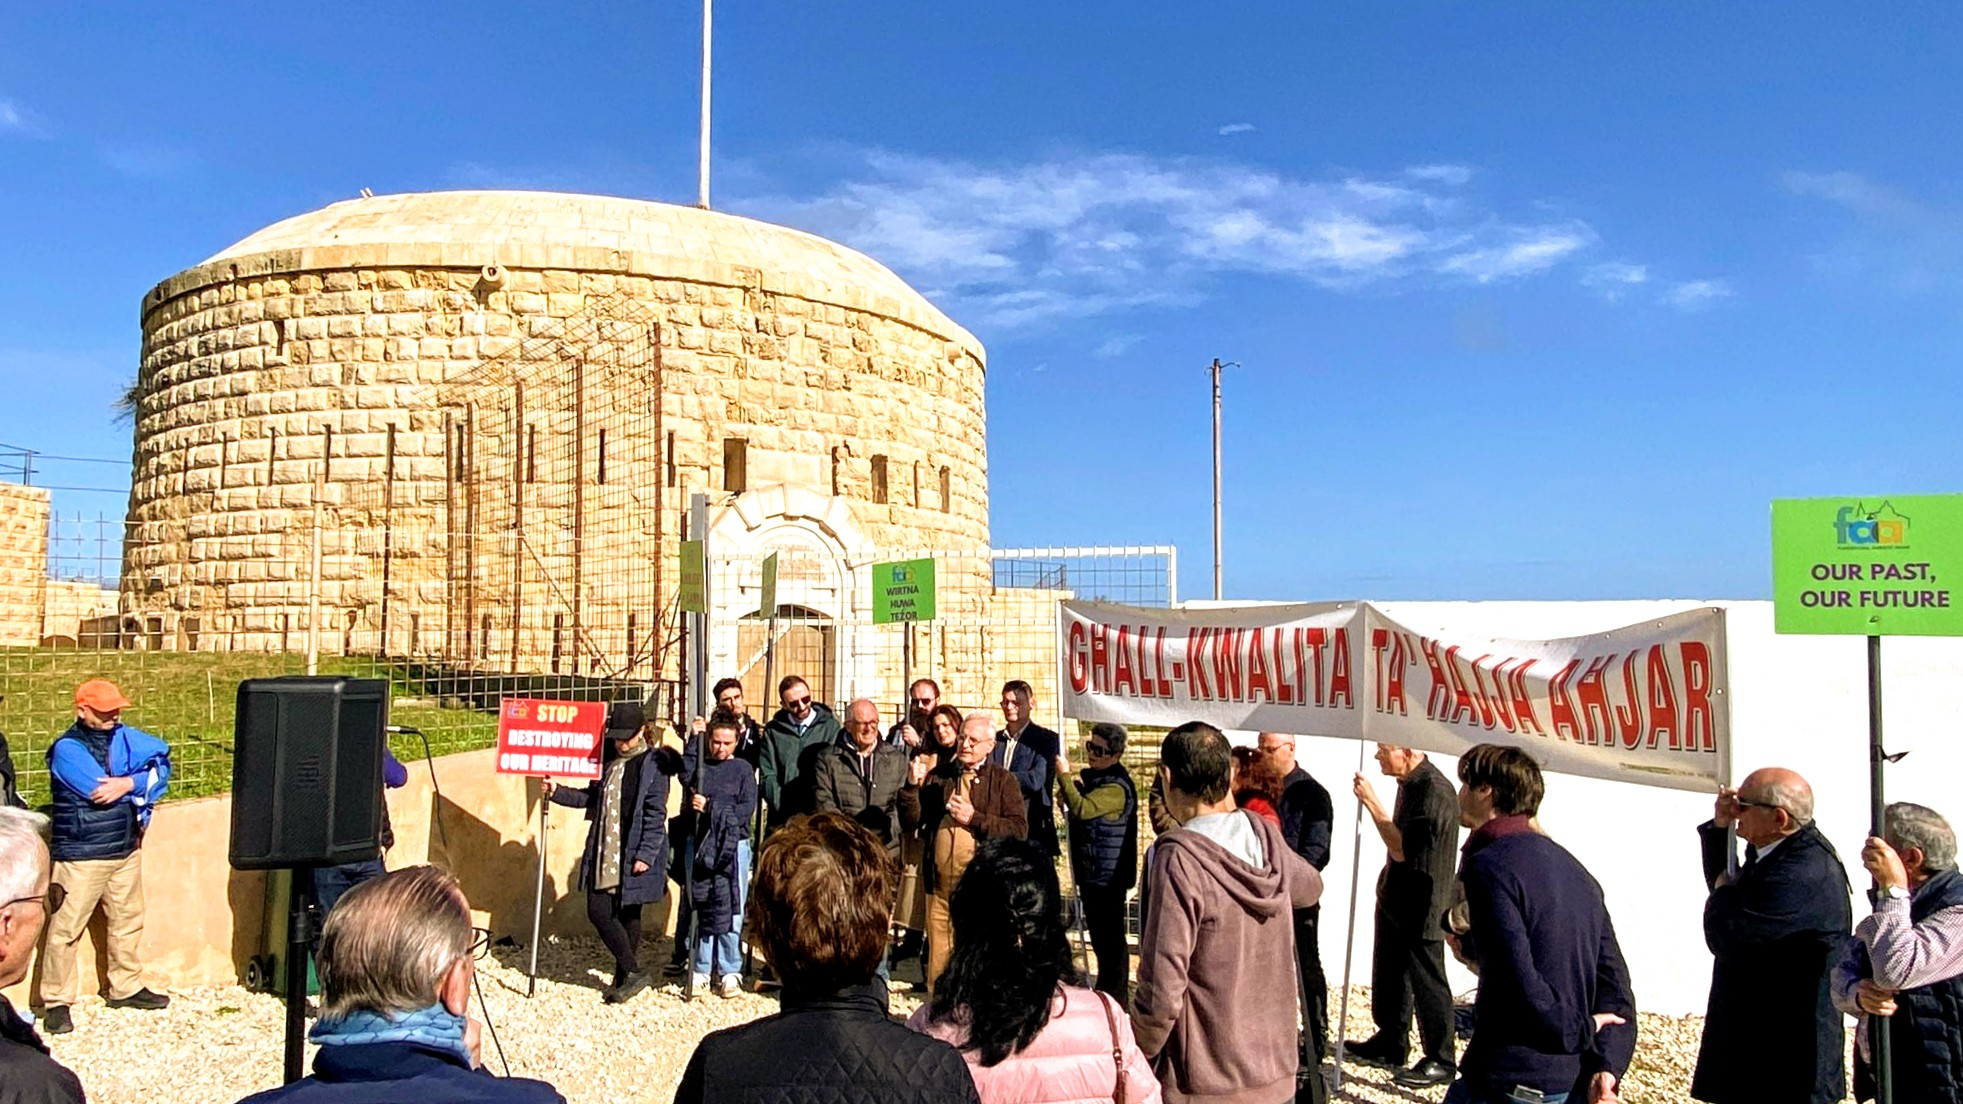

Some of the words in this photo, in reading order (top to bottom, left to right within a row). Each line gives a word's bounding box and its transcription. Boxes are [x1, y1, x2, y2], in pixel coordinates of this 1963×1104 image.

[1811, 563, 1863, 581] OUR
[1871, 563, 1936, 584] PAST,
[886, 585, 920, 596] WIRTNA
[1800, 590, 1852, 608] OUR
[1860, 590, 1950, 608] FUTURE
[537, 704, 579, 723] STOP
[508, 729, 594, 750] DESTROYING
[500, 753, 530, 771] OUR
[531, 754, 598, 774] HERITAGE
